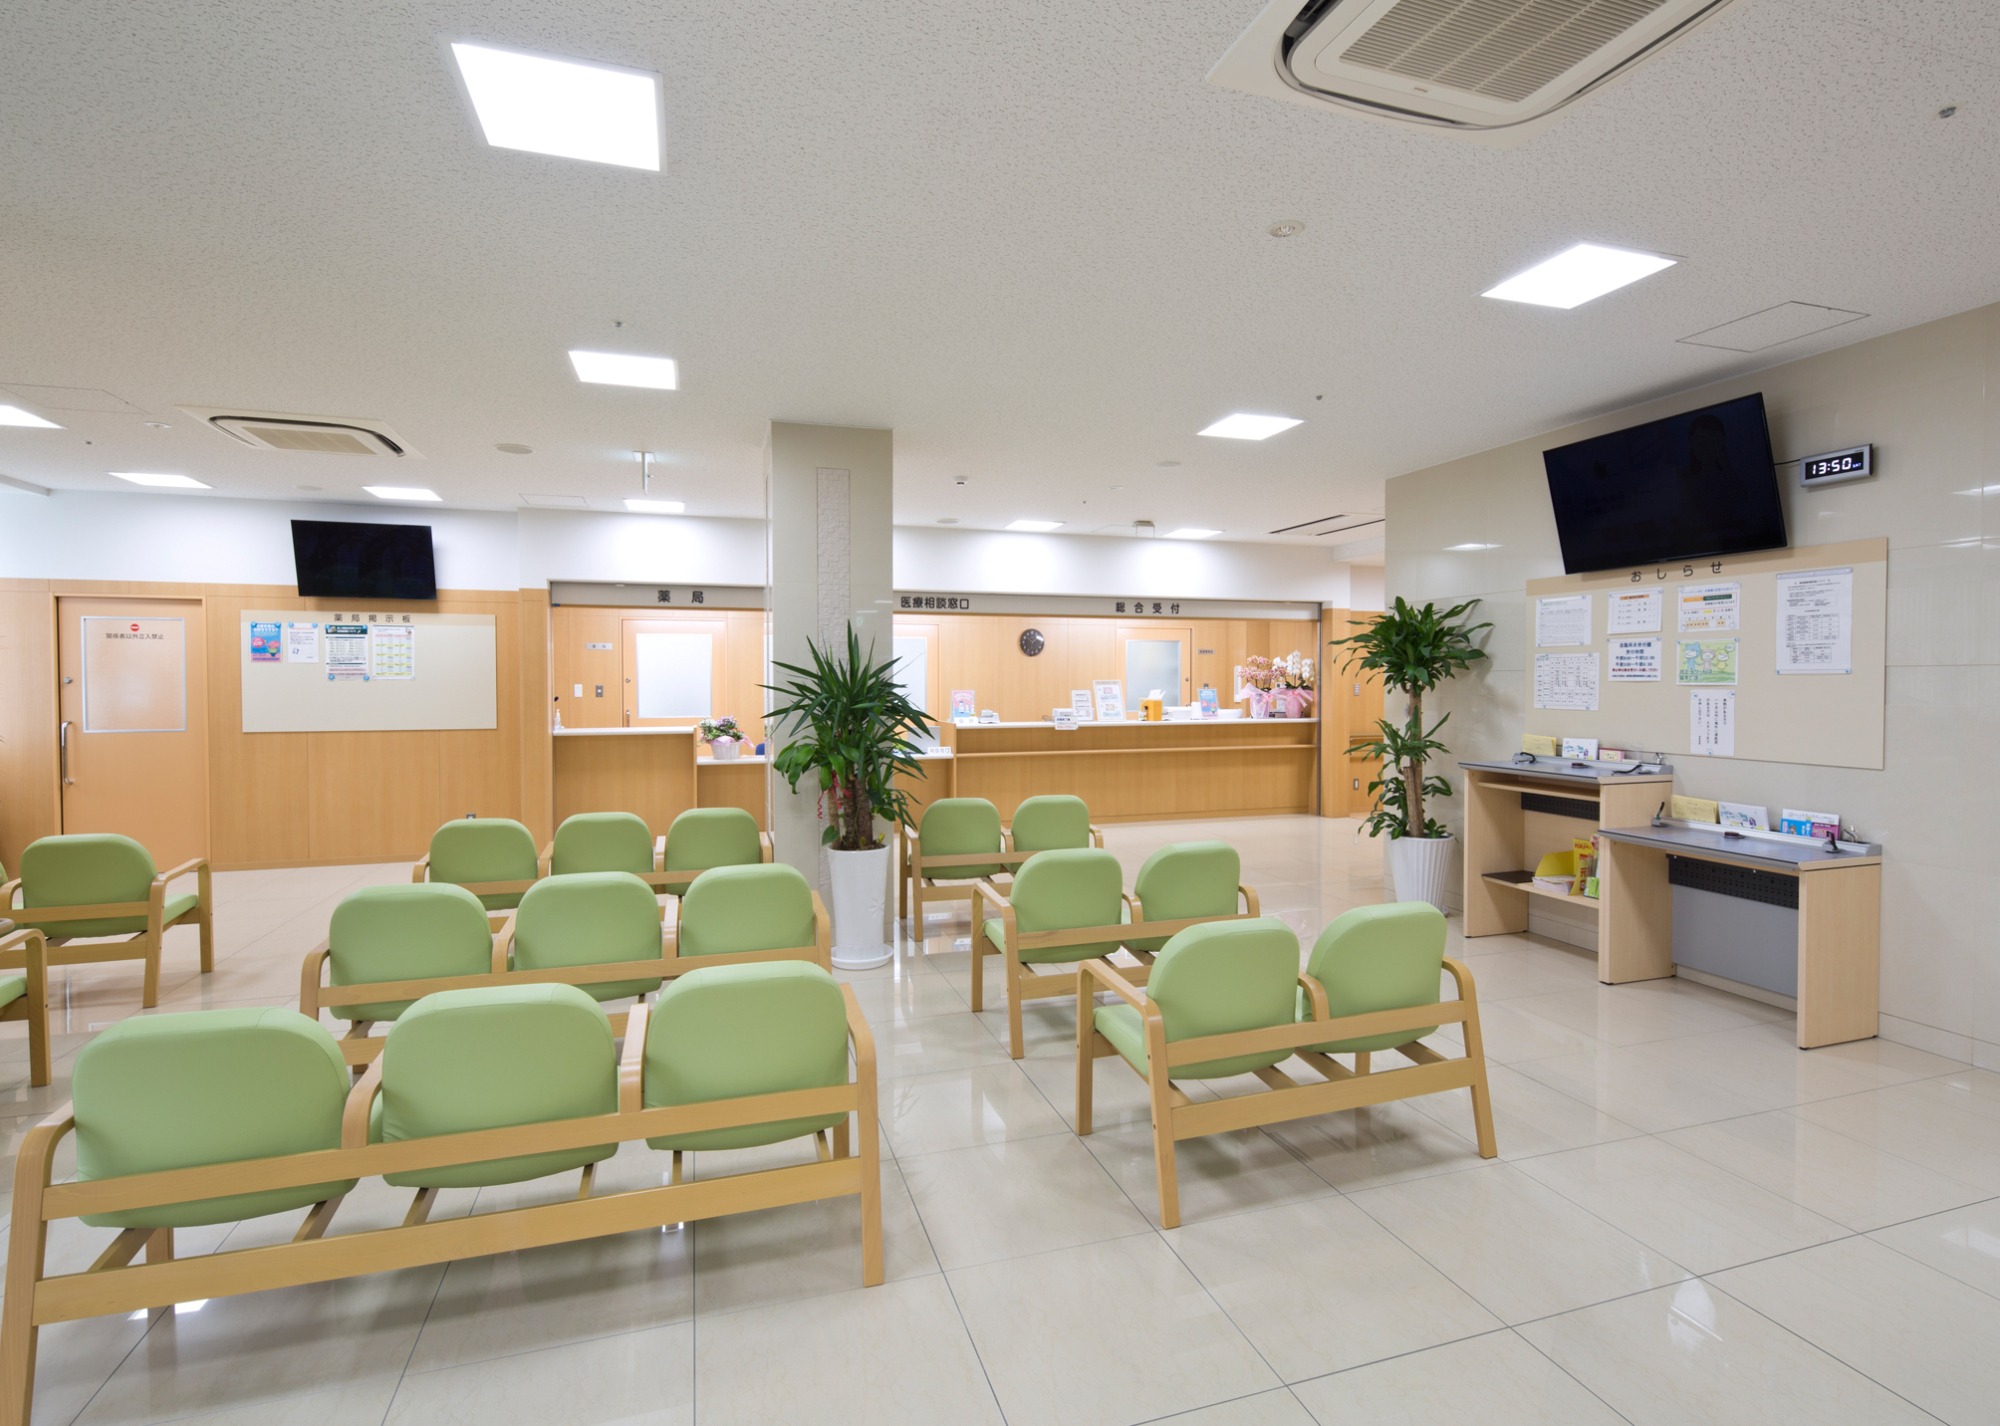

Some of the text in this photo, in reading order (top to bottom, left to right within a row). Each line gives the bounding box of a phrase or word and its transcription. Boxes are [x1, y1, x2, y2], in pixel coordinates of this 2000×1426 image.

[1812, 457, 1852, 475] 13:50
[1630, 561, 1723, 583] おしらせ
[657, 589, 704, 604] 薬局
[900, 596, 969, 609] 医療相談窓口
[1115, 602, 1180, 614] 総合受付
[333, 613, 411, 623] 薬局掲示板
